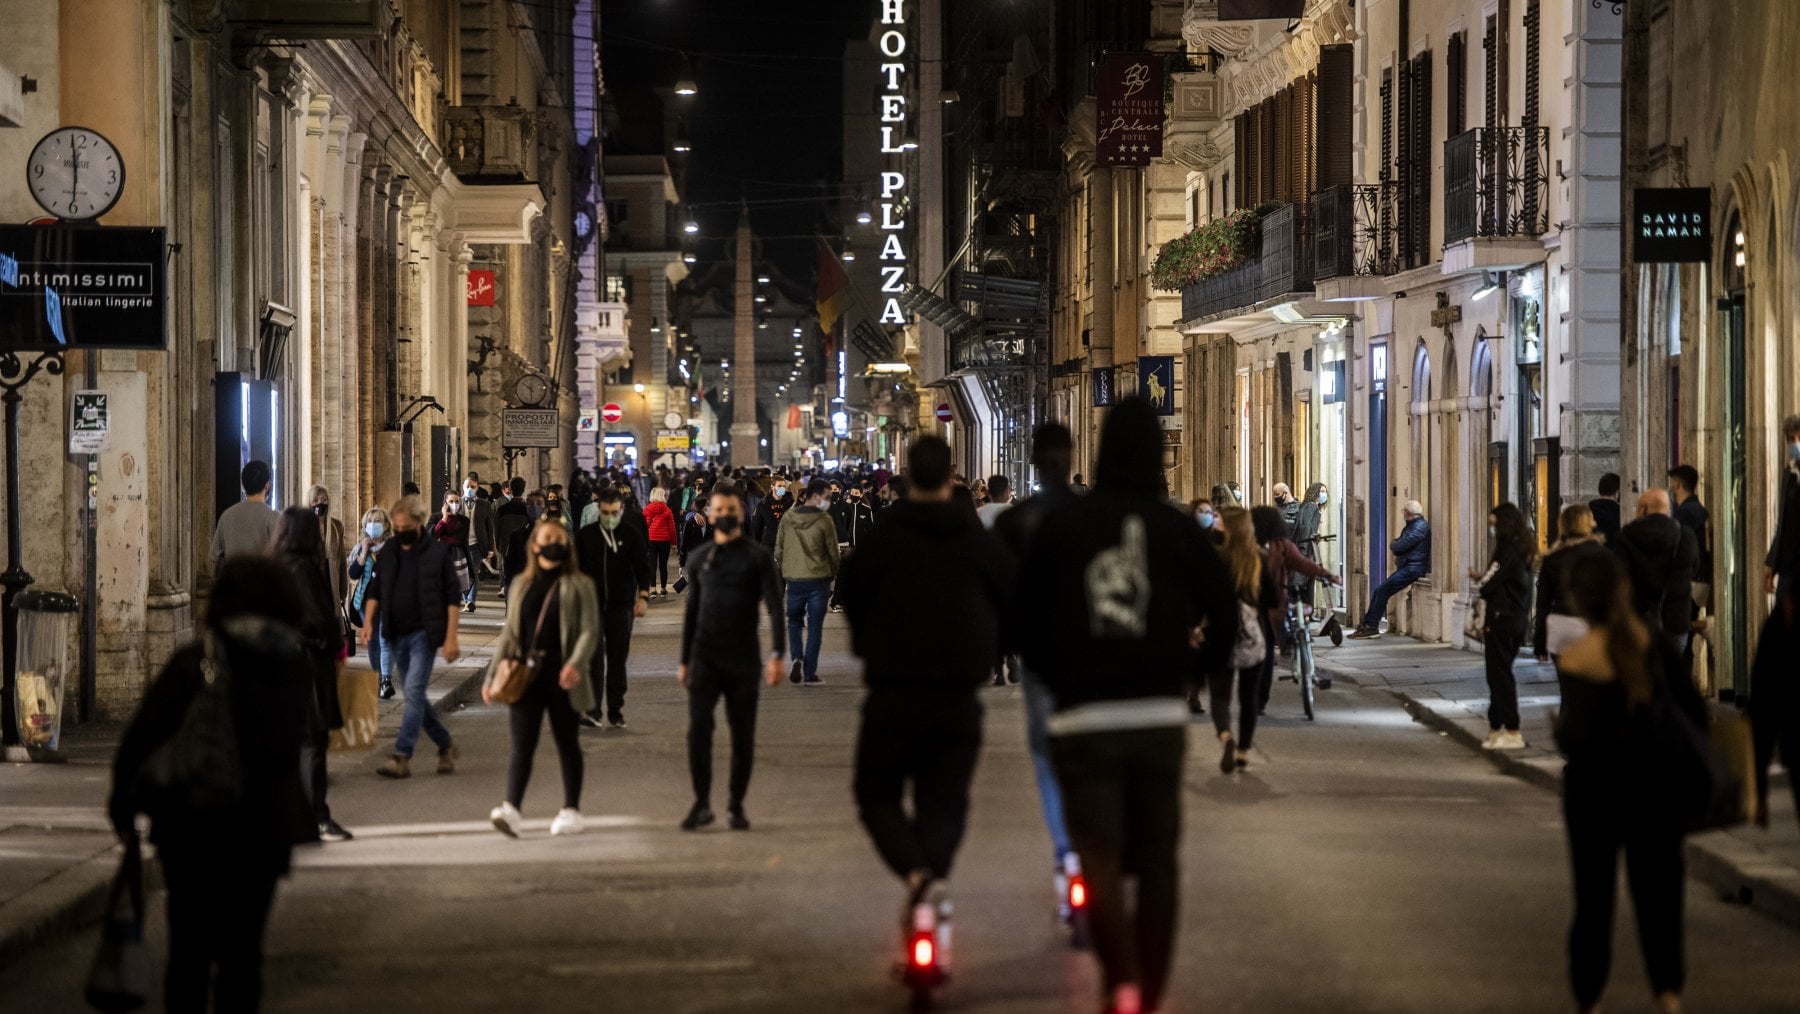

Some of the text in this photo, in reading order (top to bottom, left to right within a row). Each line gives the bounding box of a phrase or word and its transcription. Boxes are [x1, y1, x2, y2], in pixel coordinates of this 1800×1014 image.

[1109, 116, 1160, 134] Palace
[880, 0, 906, 324] HOTEL PLAZA
[1642, 212, 1702, 224] DAVID
[1642, 226, 1702, 237] NAMAN
[62, 296, 153, 309] Italian lingerie
